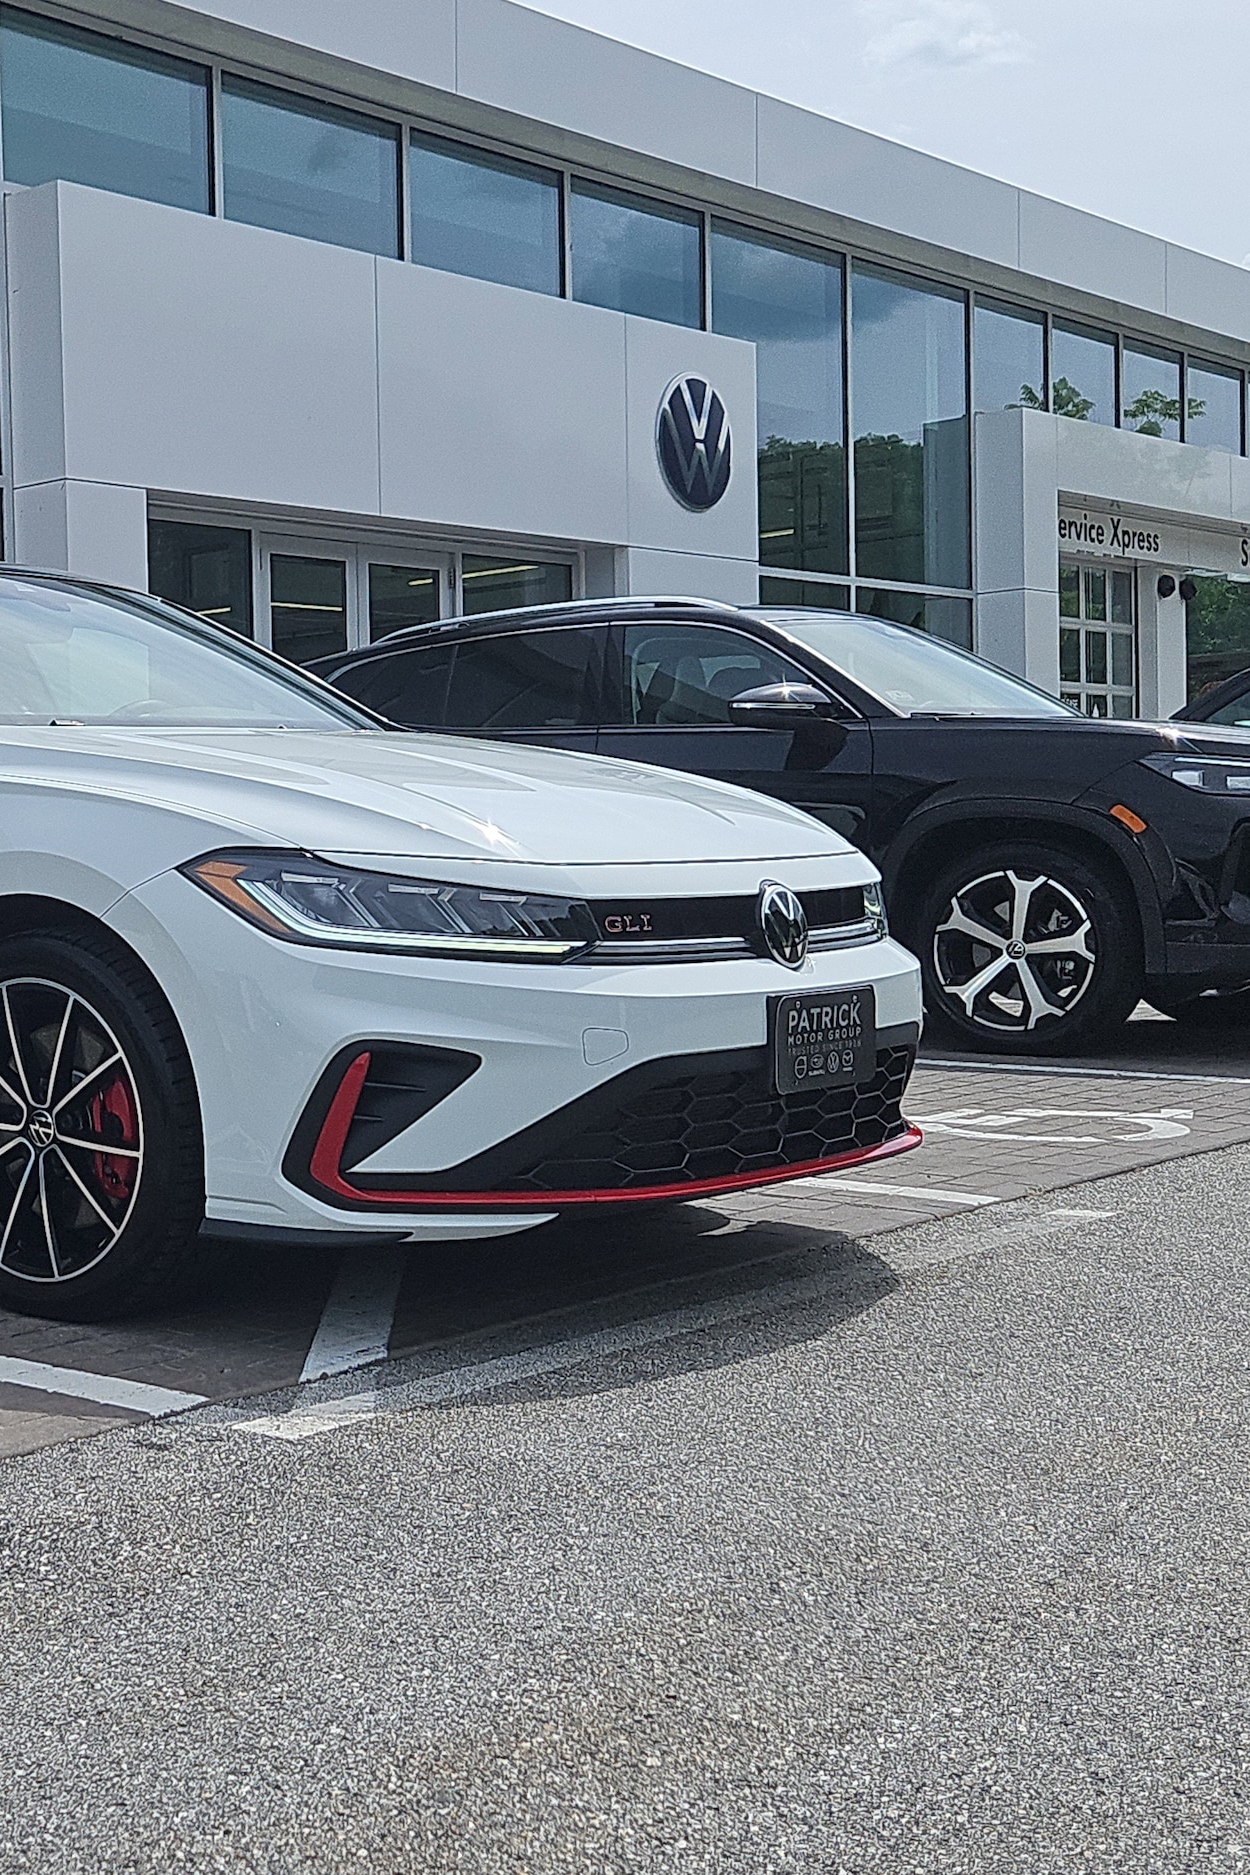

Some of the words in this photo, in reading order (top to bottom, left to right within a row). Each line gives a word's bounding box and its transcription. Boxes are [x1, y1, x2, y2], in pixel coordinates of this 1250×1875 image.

[1058, 512, 1105, 545] ervice
[1110, 517, 1160, 555] Xpress
[604, 914, 653, 933] GLI
[788, 1002, 862, 1034] PATRICK
[788, 1031, 823, 1047] MOTOR
[828, 1026, 862, 1041] GROUP
